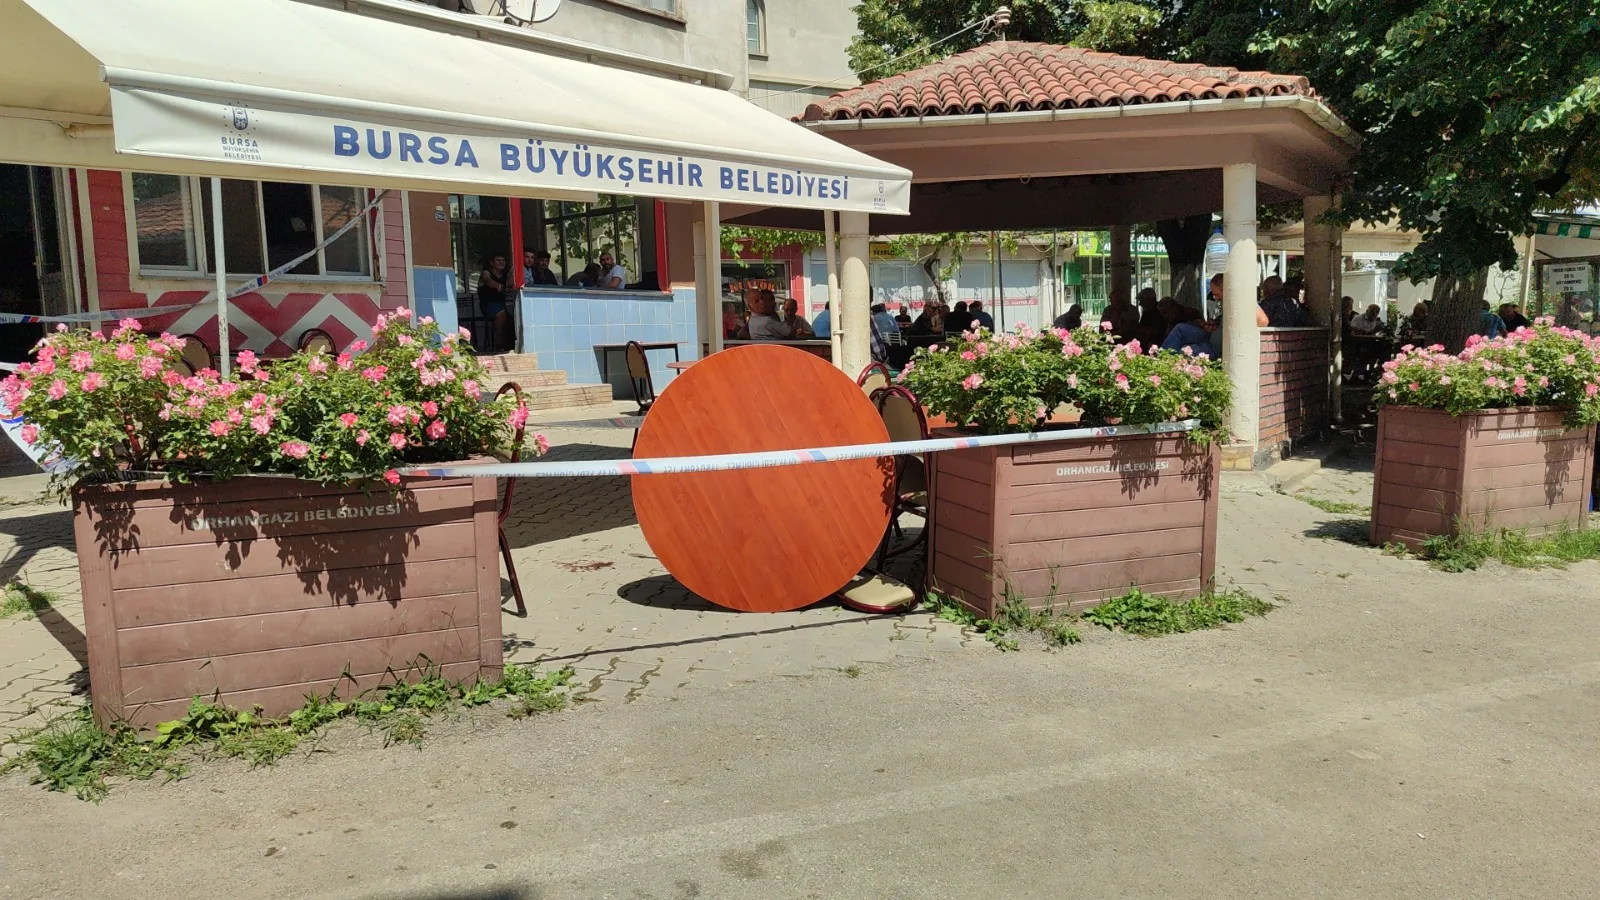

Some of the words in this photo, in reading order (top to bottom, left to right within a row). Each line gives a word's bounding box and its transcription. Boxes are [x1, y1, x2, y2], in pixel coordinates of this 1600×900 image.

[221, 136, 259, 147] BURSA
[333, 124, 479, 168] BURSA
[500, 138, 704, 188] BÜYÜKŞEHİR
[720, 166, 849, 200] BELEDİYESİ
[191, 511, 299, 530] ORHANGAZİ
[304, 502, 401, 522] BELEDİYESİ
